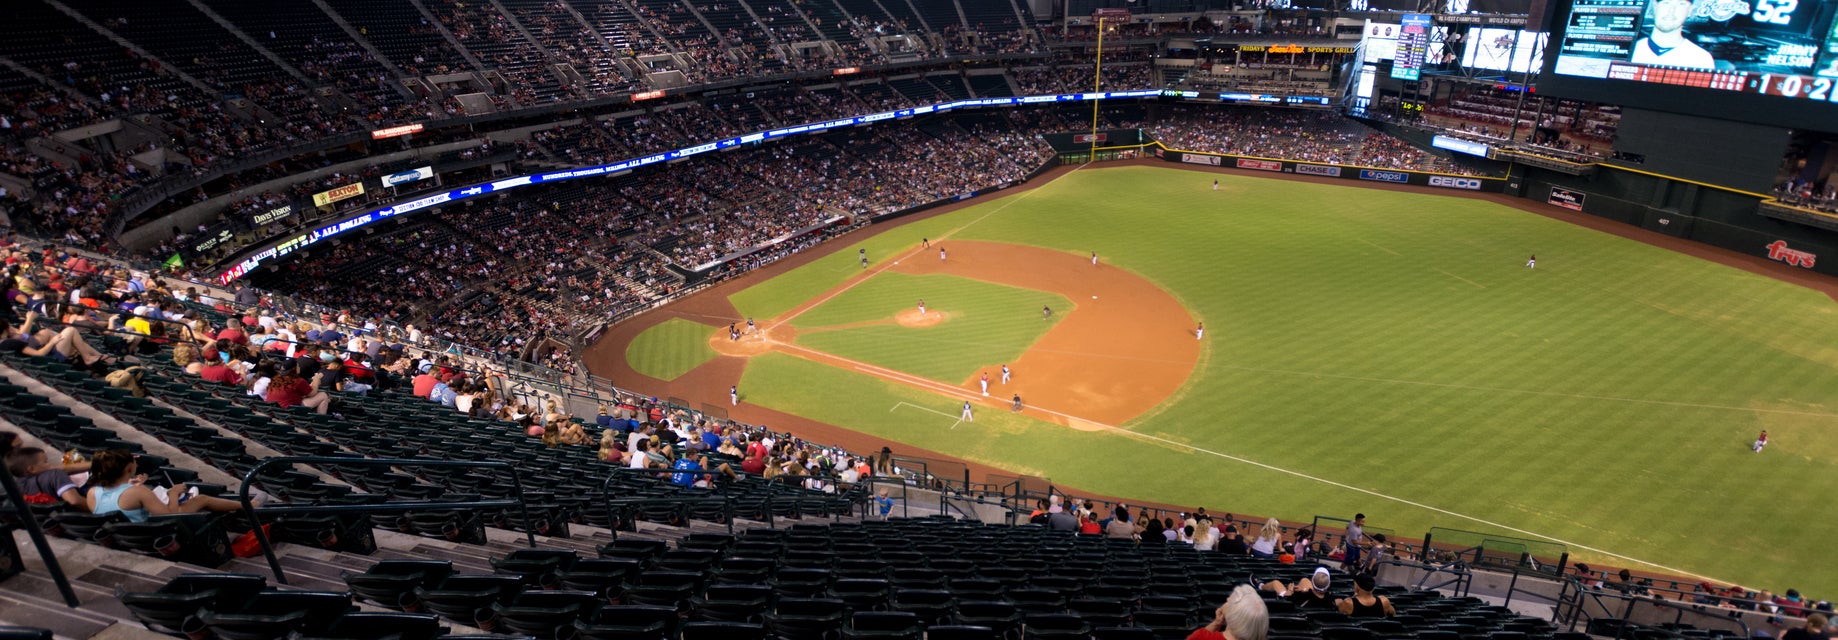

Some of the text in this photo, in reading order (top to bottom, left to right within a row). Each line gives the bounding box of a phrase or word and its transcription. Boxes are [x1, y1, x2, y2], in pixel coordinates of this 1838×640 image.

[1752, 0, 1798, 25] 52
[1777, 44, 1818, 57] JIMMY
[1766, 54, 1814, 67] NELSON
[1759, 74, 1771, 93] 1
[1781, 75, 1802, 97] 0
[1808, 77, 1831, 100] 2
[1300, 165, 1328, 174] CHASE
[1376, 171, 1401, 182] pepsi
[1429, 175, 1481, 190] GEICO
[328, 184, 359, 199] SEXTON
[1551, 191, 1576, 201] Safelite
[253, 212, 272, 224] DAVIS
[271, 205, 292, 217] VISION
[322, 224, 339, 238] ALL
